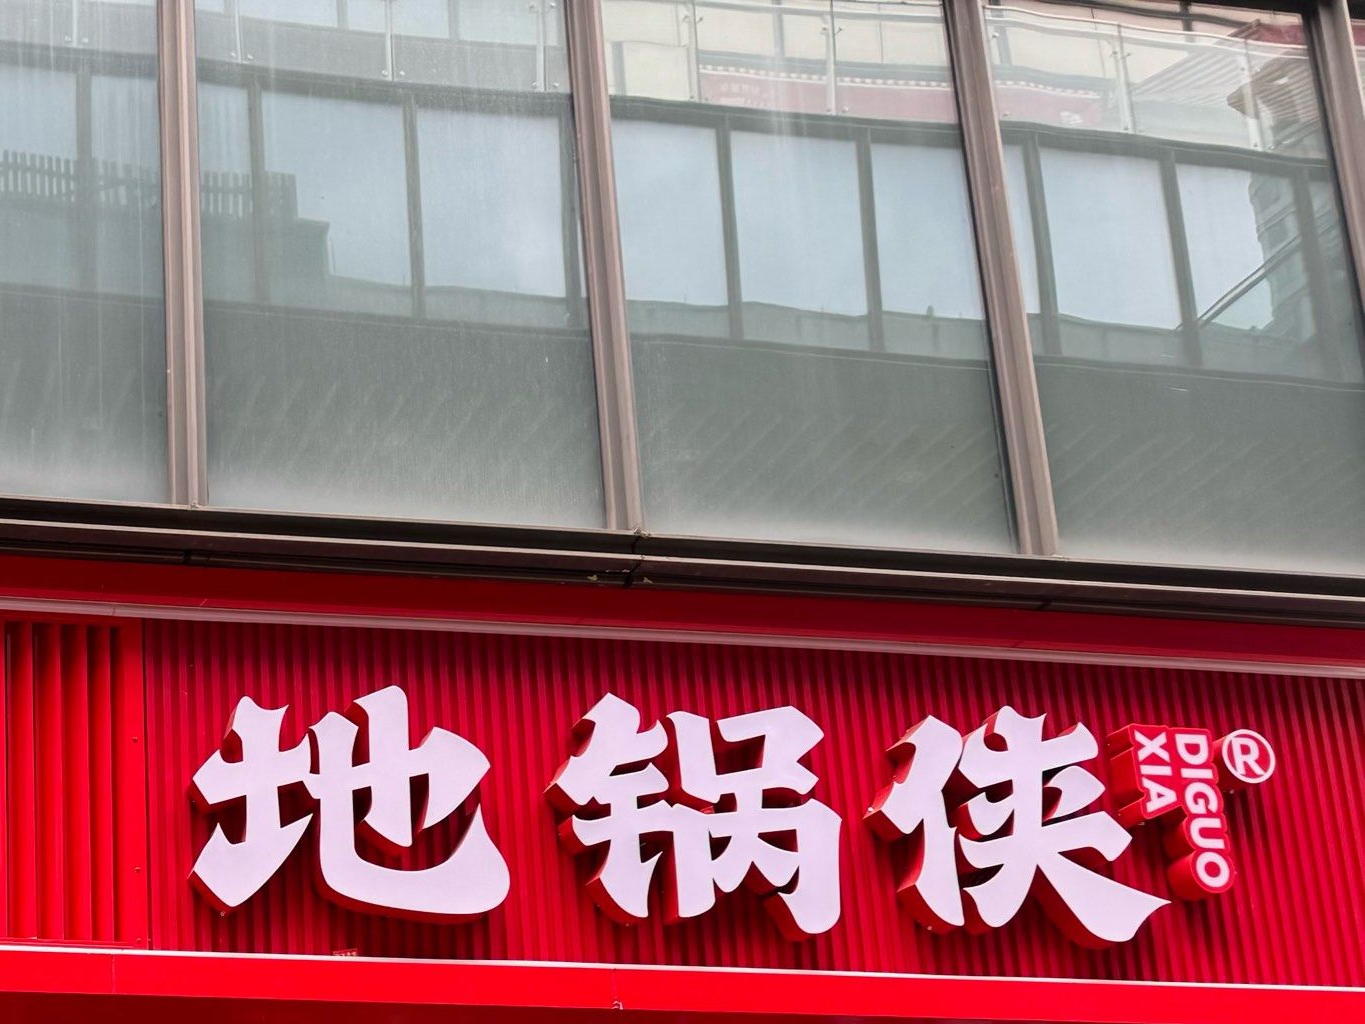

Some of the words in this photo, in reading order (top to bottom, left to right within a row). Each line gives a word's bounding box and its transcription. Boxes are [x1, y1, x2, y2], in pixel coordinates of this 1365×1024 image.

[192, 685, 1171, 942] 地锅侠
[1134, 730, 1177, 813] XIA
[1174, 733, 1230, 888] DIGUO
